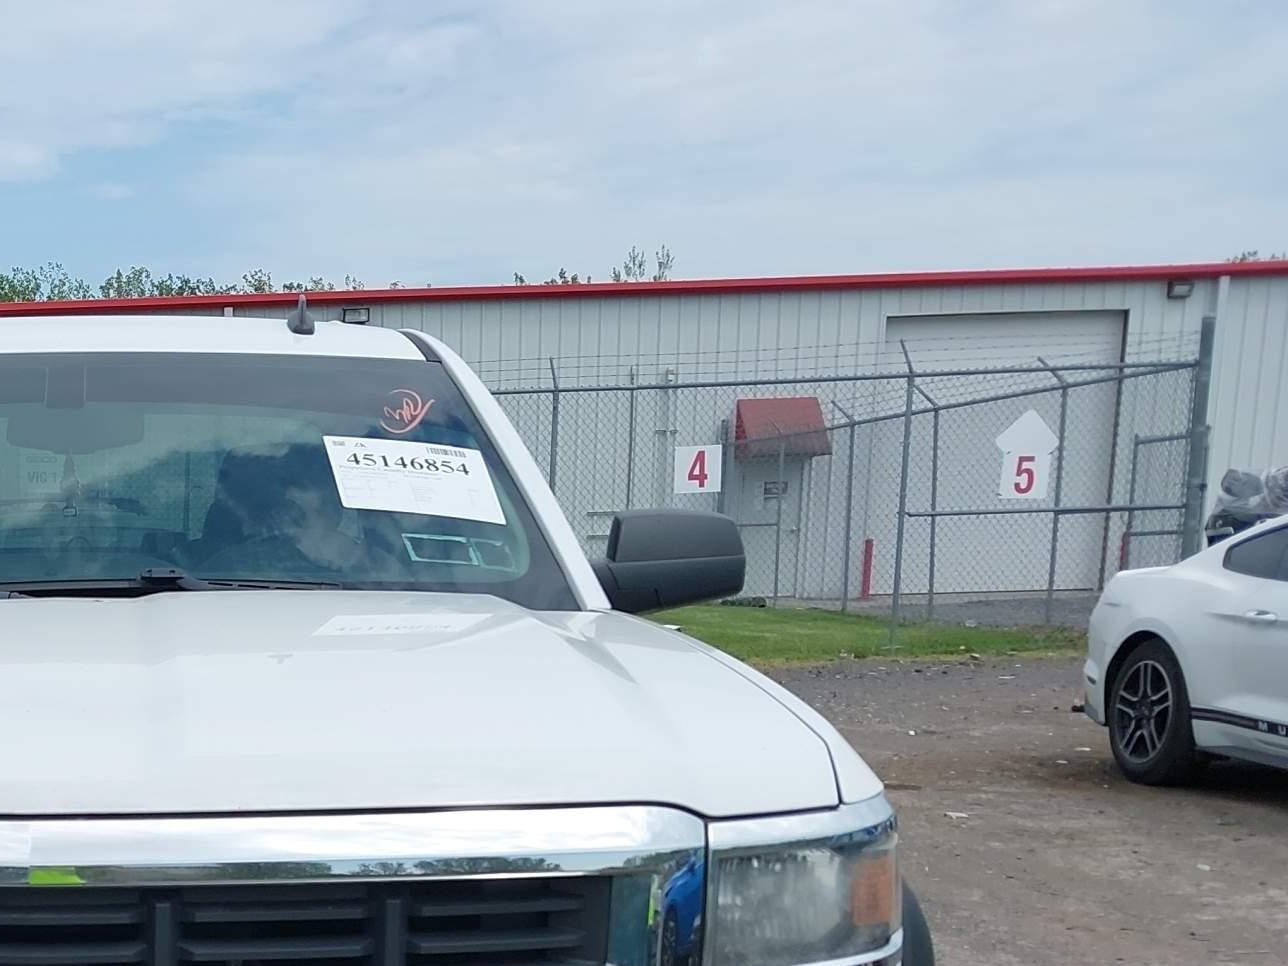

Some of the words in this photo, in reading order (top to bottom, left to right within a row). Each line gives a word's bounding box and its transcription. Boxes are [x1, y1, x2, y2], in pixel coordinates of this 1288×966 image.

[346, 452, 470, 476] 45146854
[688, 450, 708, 488] 4
[1014, 455, 1036, 494] 5
